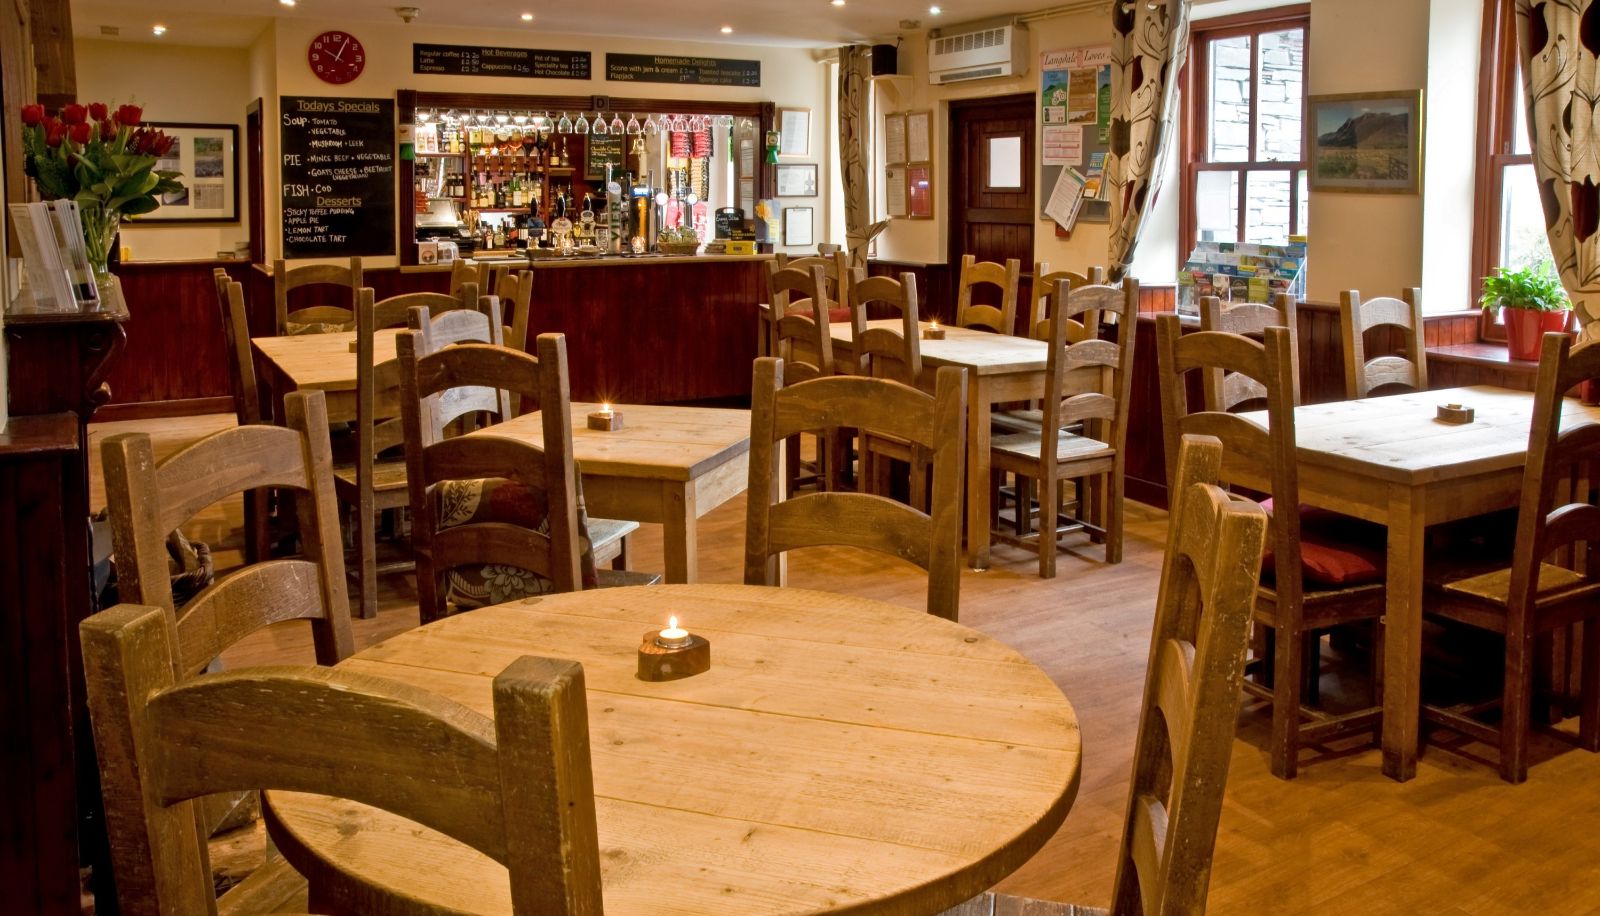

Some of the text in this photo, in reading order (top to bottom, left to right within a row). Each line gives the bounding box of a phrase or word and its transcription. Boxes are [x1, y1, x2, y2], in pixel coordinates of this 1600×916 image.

[333, 34, 342, 42] 12
[312, 53, 319, 61] 9
[1044, 50, 1105, 68] Langdale Loves
[297, 100, 380, 114] Todays Specials
[284, 154, 302, 166] PIE
[284, 184, 310, 197] FISH
[316, 196, 362, 206] Desserts
[288, 234, 347, 244] CHOCOLATE TART
